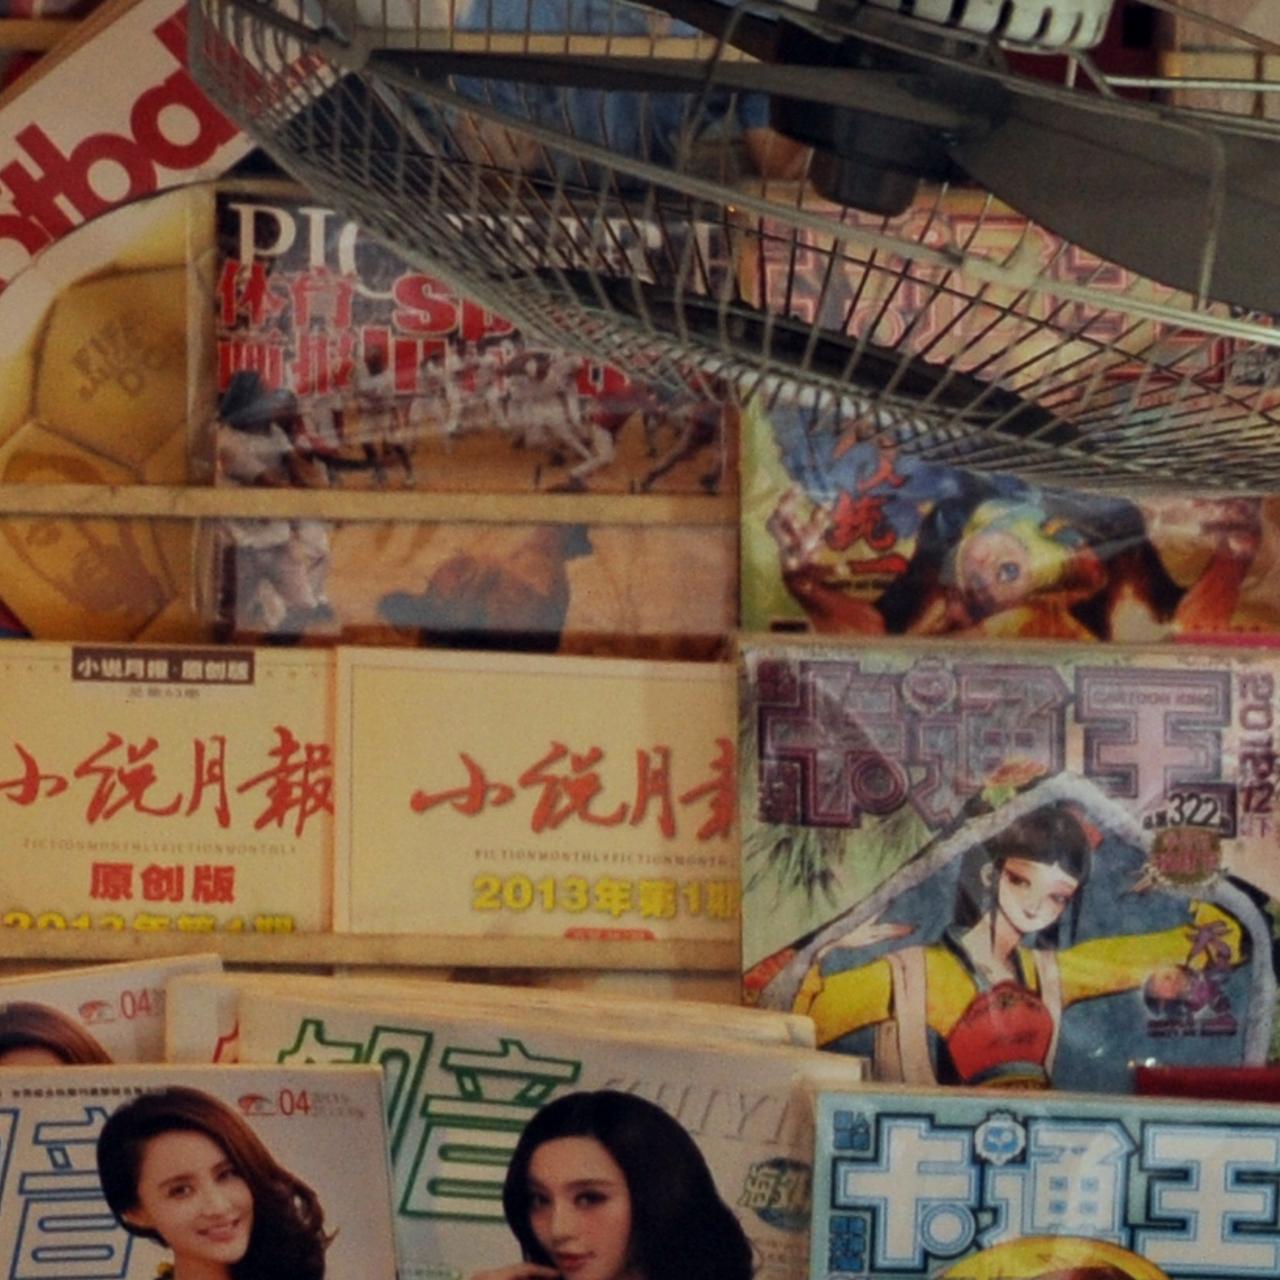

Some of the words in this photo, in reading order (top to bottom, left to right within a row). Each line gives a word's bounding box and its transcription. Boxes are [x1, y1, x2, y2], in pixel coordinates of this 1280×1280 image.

[89, 863, 236, 905] 原创版
[473, 876, 742, 921] 2013年第1期
[119, 989, 152, 1020] 04
[278, 1087, 312, 1118] 04
